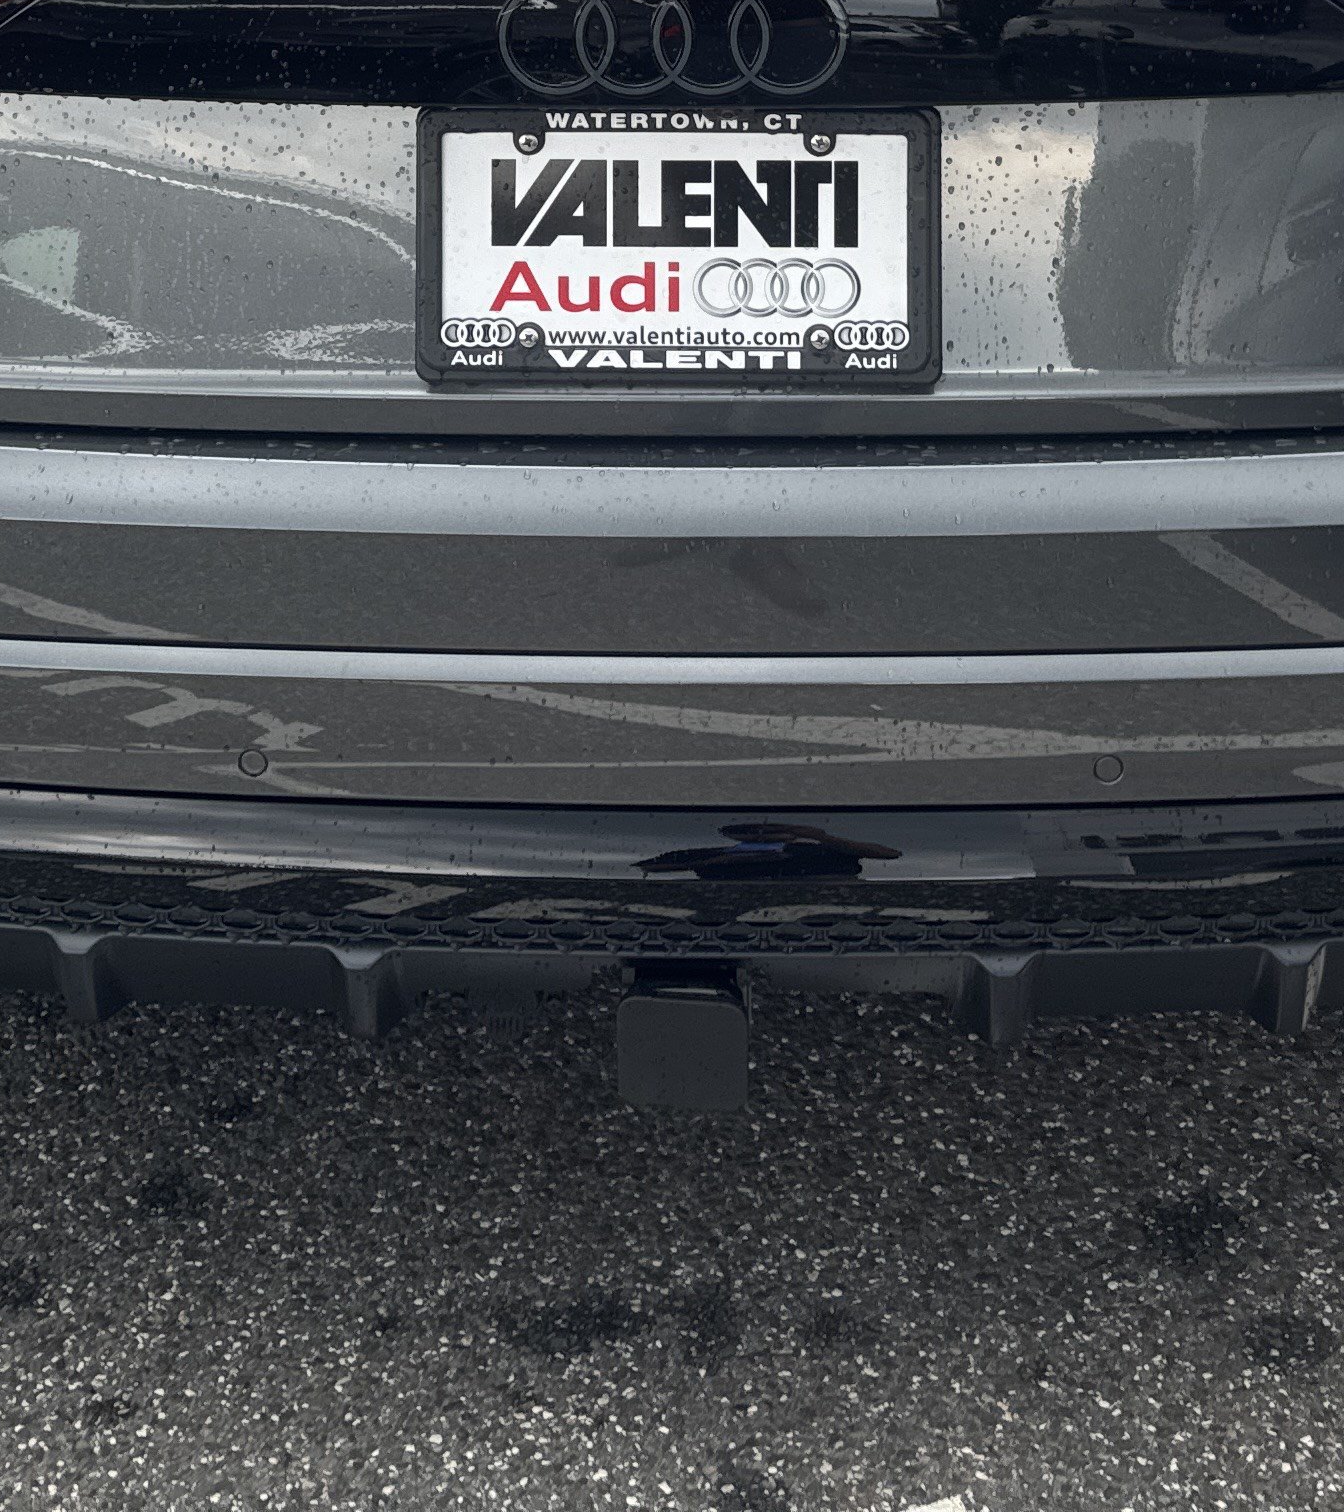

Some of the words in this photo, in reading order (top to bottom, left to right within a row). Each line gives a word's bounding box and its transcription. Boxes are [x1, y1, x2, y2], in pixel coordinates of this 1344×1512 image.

[546, 113, 750, 131] WATERTOWN,
[764, 114, 803, 131] CT
[491, 159, 859, 248] VALENTI
[489, 260, 681, 313] Audi
[548, 325, 801, 347] www.valentiauto.com
[451, 350, 503, 367] Audi
[548, 349, 801, 370] VALENTI
[845, 352, 898, 371] Audi
